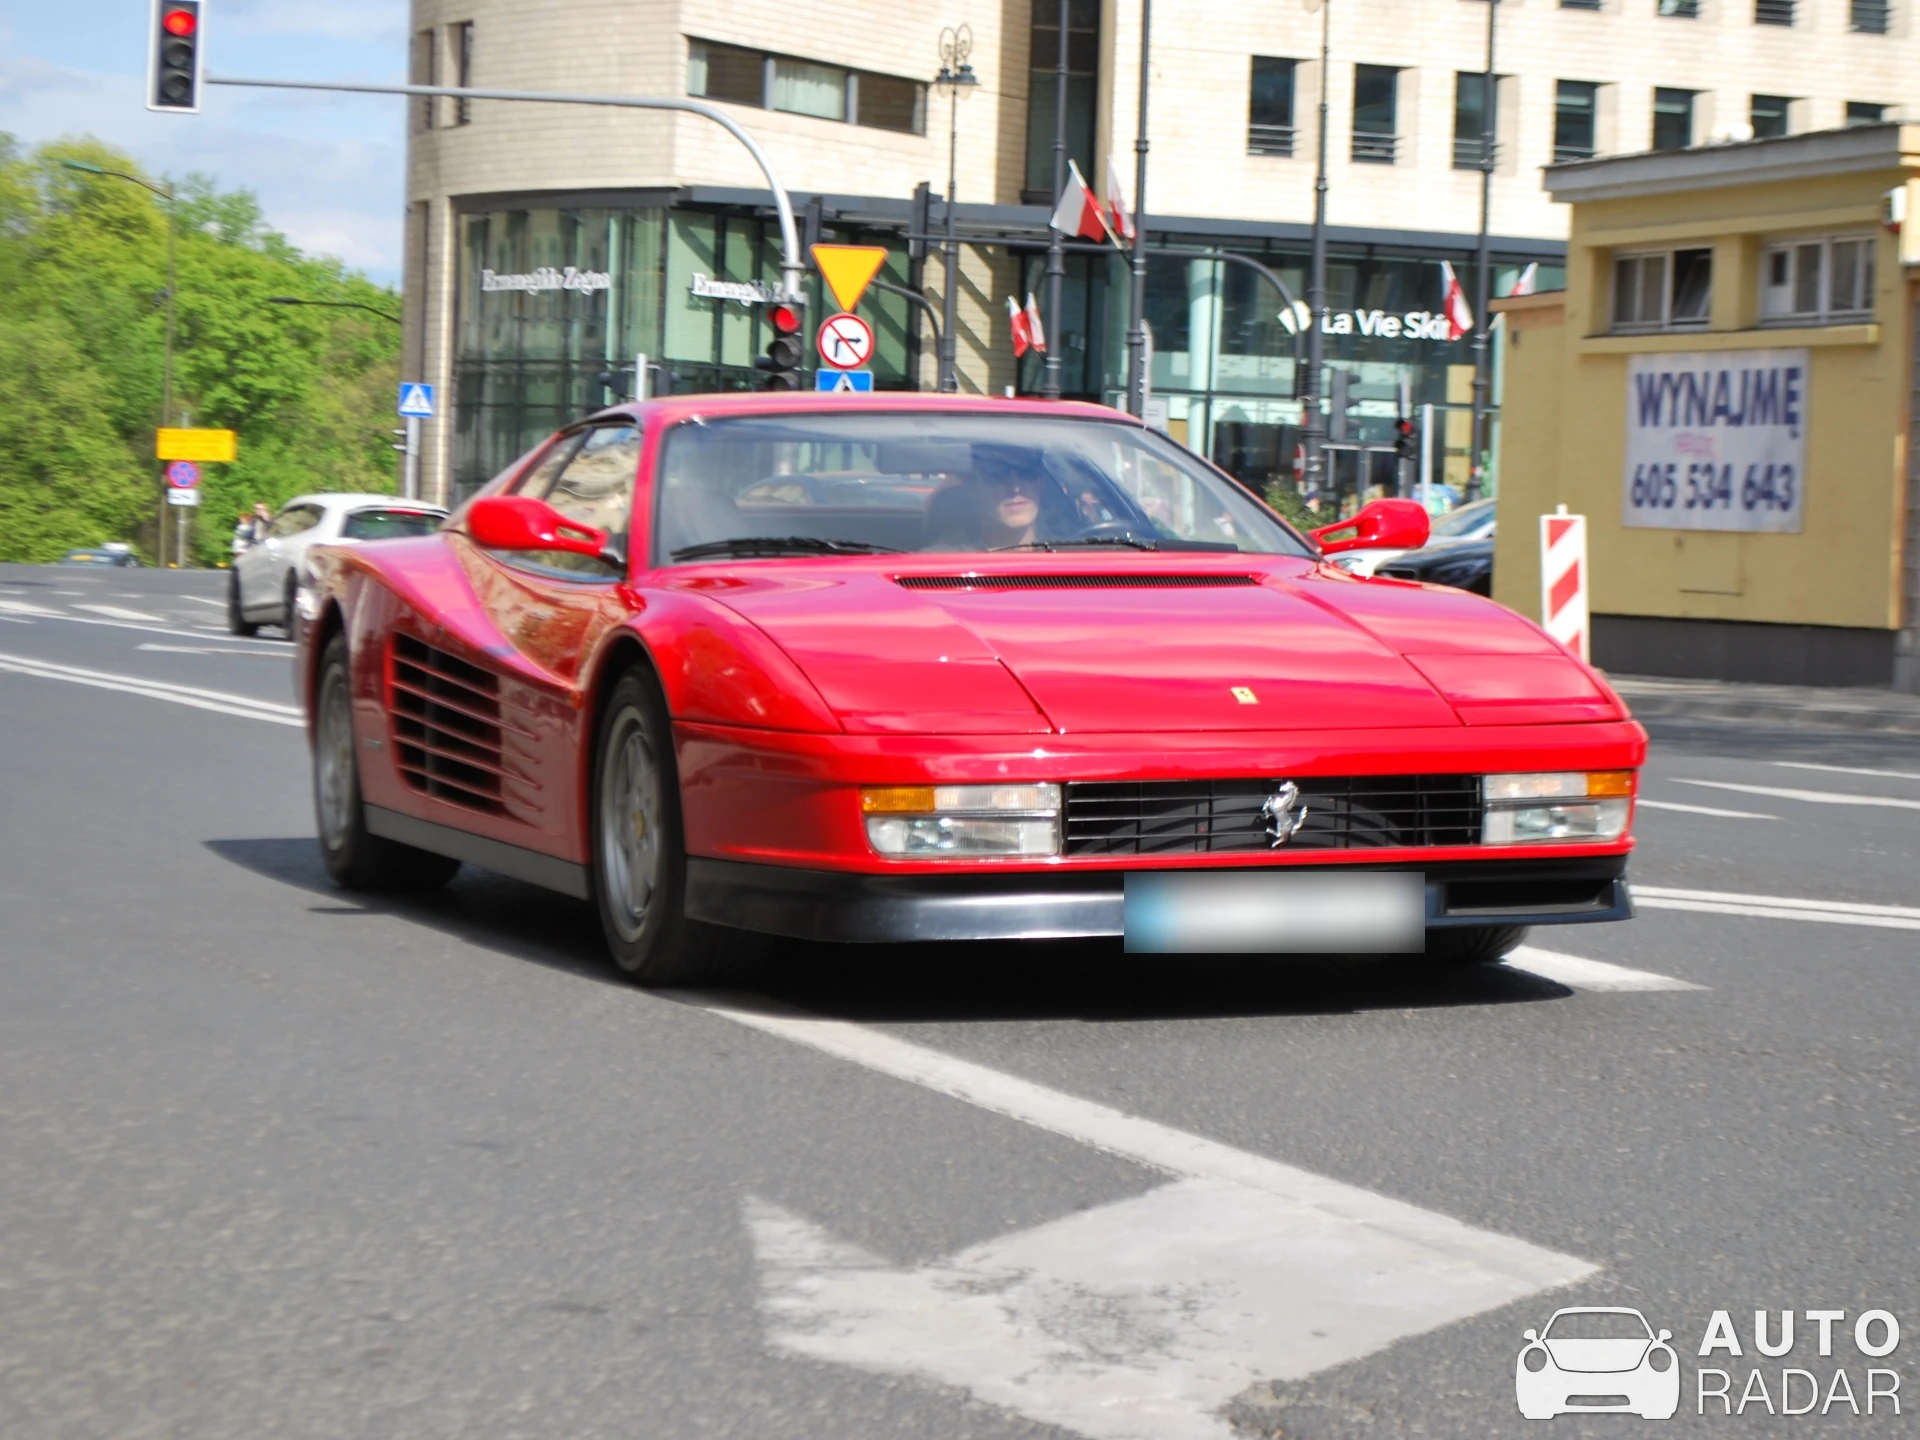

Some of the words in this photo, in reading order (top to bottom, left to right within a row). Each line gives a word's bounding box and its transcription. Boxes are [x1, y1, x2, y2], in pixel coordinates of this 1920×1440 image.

[1321, 306, 1352, 335] La
[1355, 307, 1401, 338] Vie
[1636, 367, 1801, 440] WYNAJMĘ
[1631, 463, 1678, 509] 605
[1685, 463, 1733, 509] 534
[1741, 463, 1794, 511] 643
